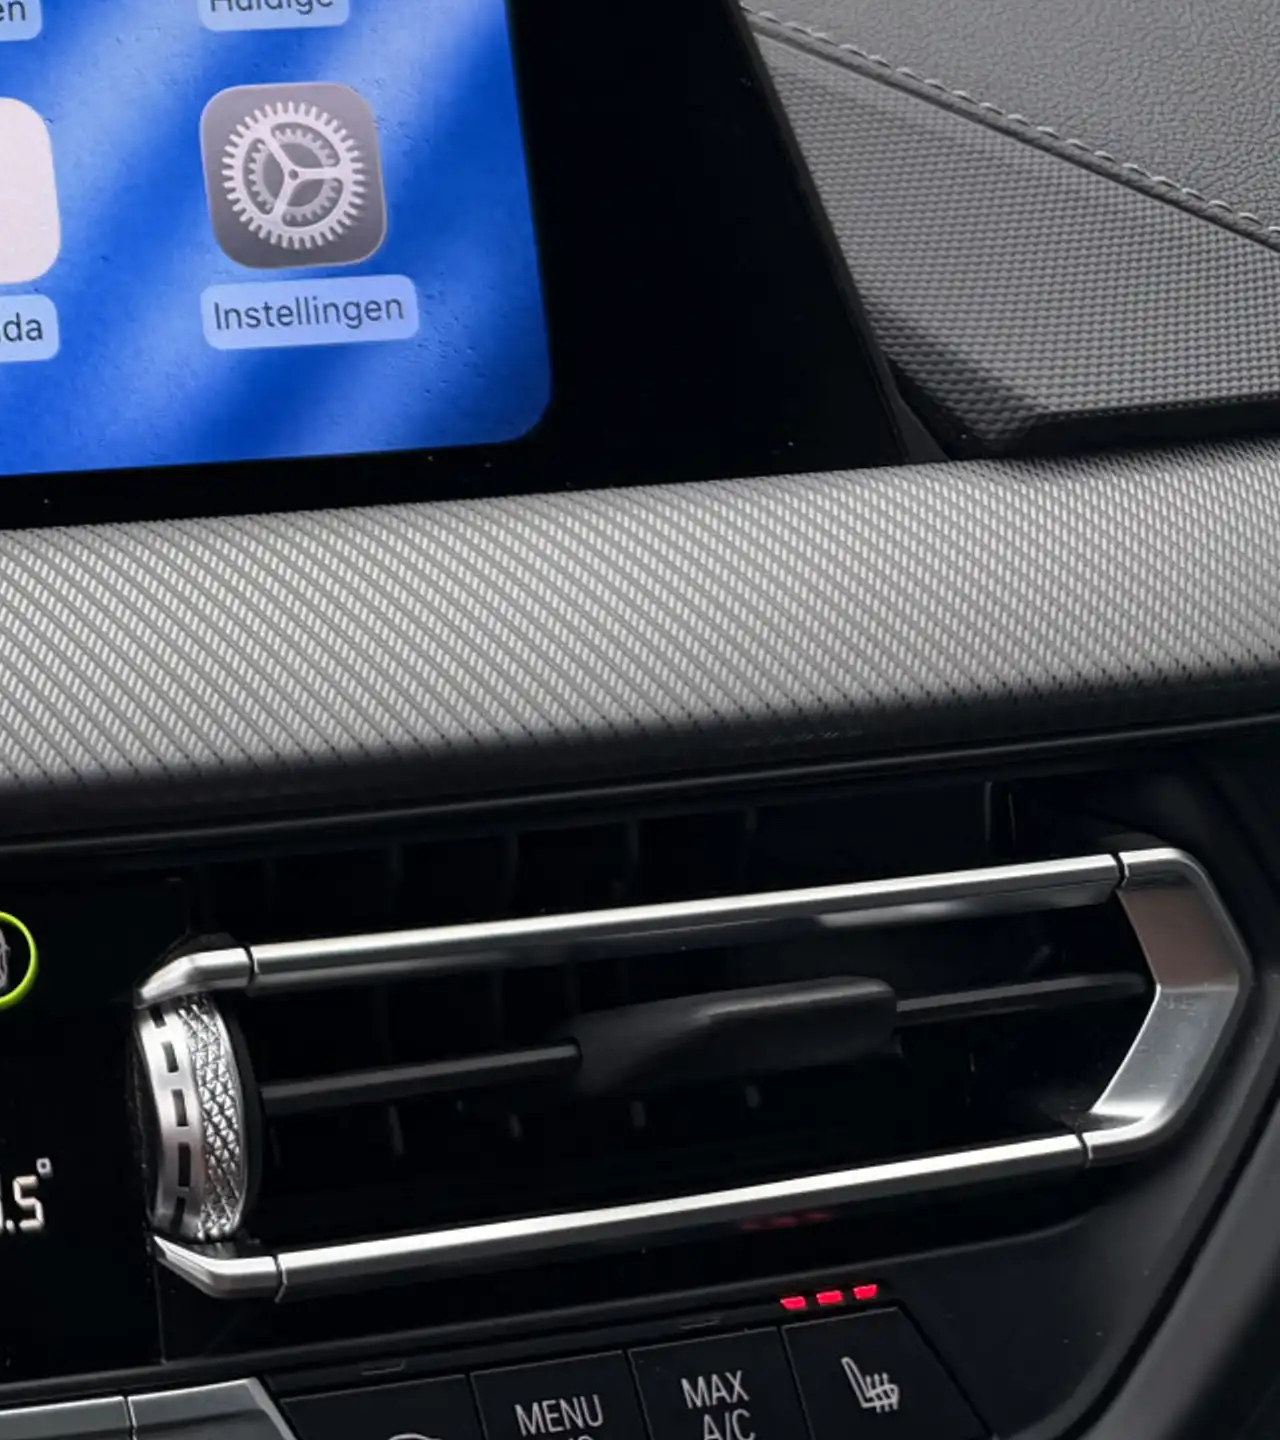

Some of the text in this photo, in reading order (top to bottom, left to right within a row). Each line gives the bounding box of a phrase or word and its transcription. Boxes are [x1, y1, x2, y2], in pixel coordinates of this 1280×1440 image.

[214, 295, 403, 331] Instellingen
[681, 1370, 749, 1409] MAX
[515, 1394, 604, 1436] MENU
[702, 1409, 755, 1440] A/C
